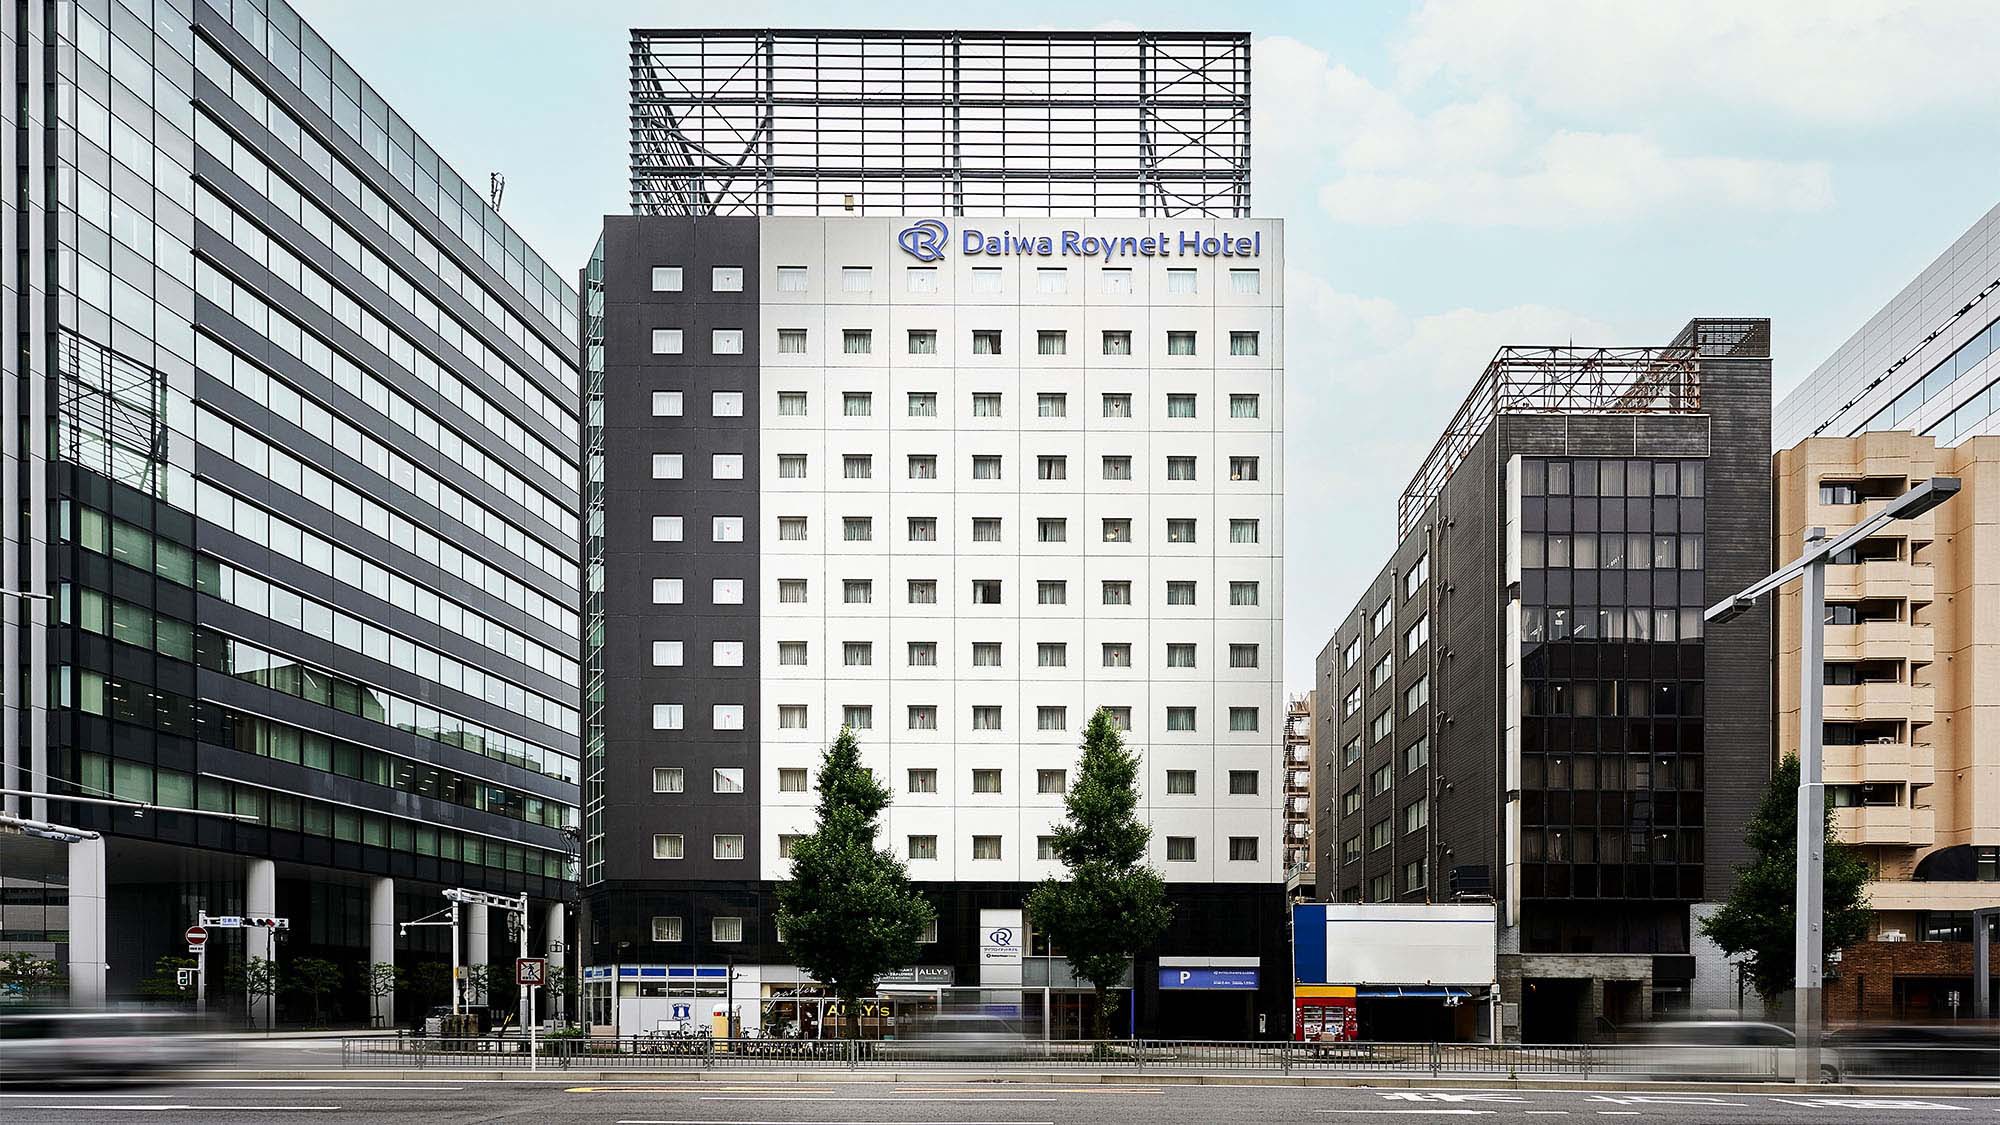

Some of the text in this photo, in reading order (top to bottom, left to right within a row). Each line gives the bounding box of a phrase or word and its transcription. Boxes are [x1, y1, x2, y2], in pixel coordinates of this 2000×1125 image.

[963, 230, 1053, 256] Daiwa
[1062, 230, 1171, 263] Roynet
[1179, 230, 1261, 257] Hotel
[1180, 971, 1191, 984] P
